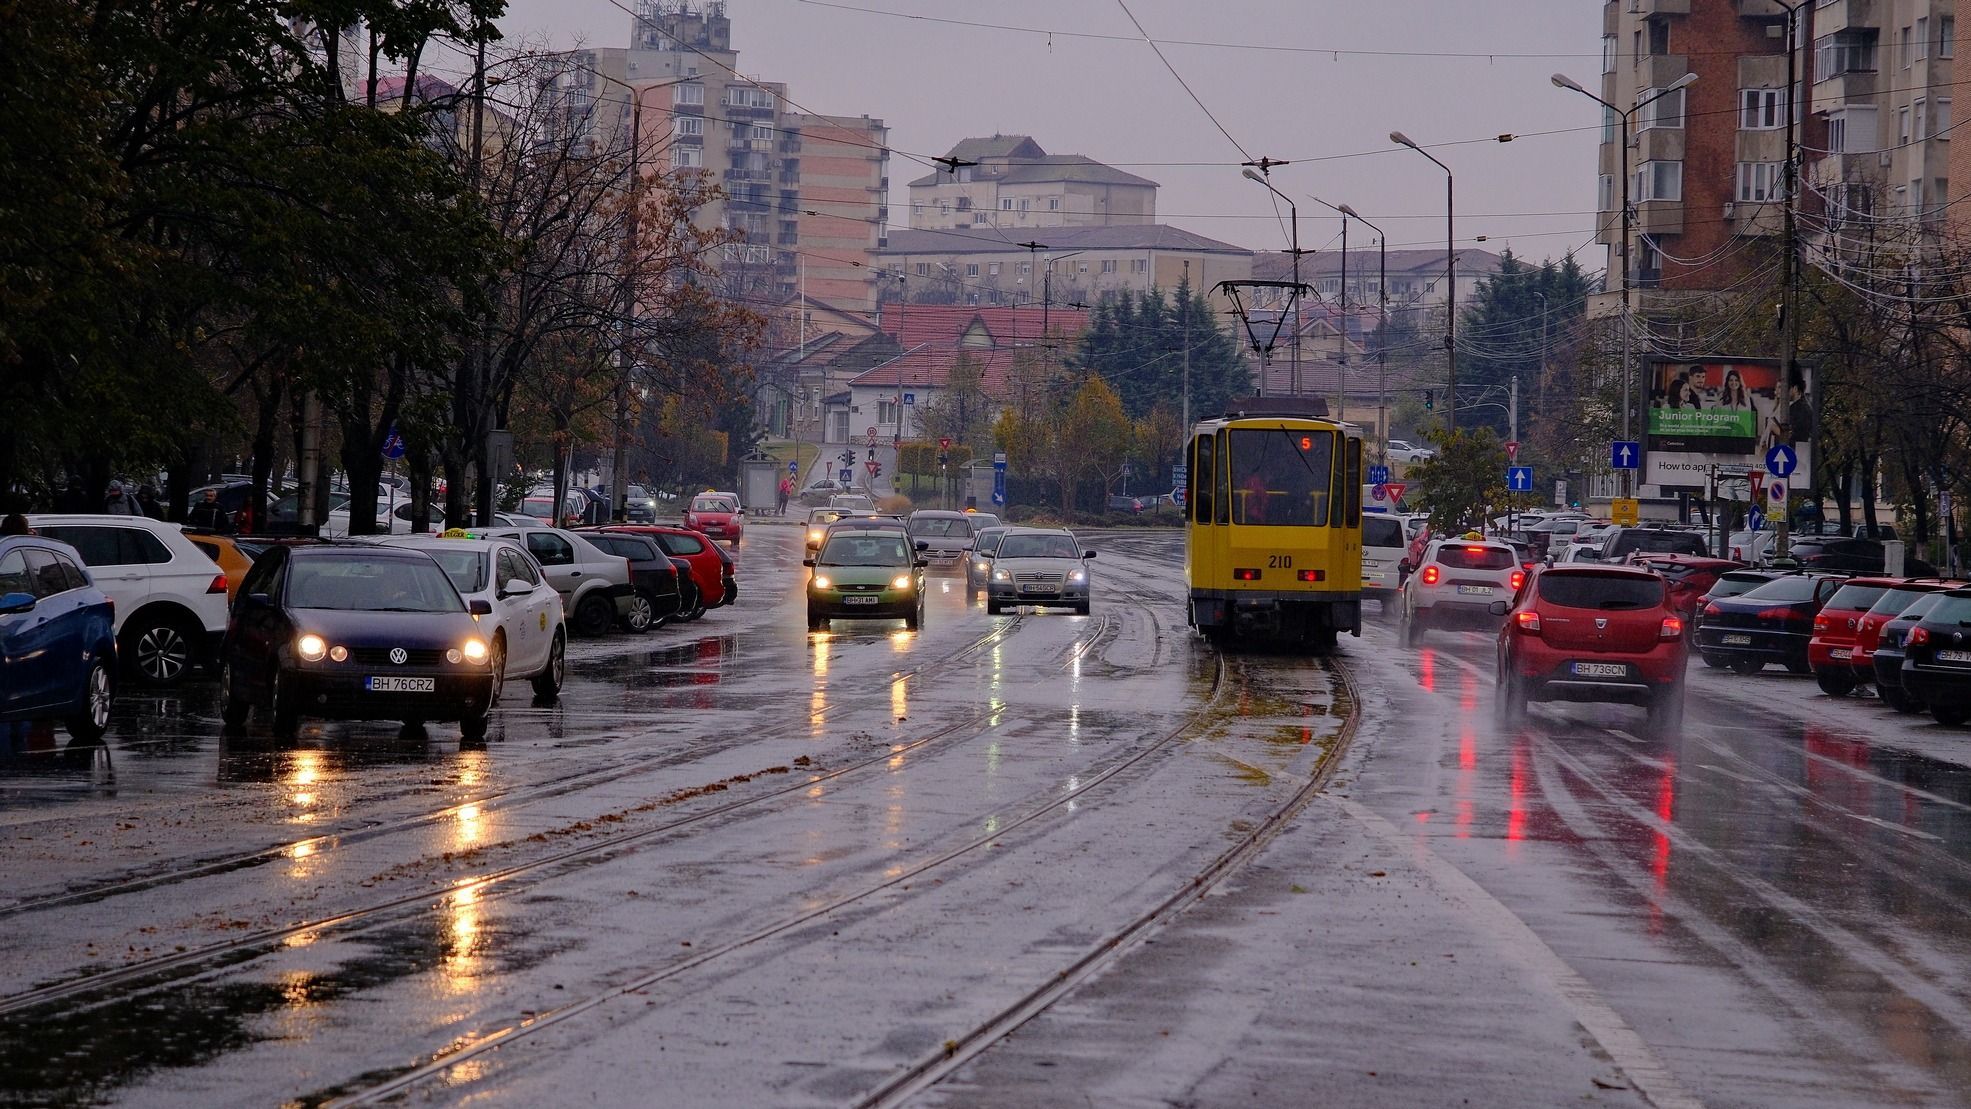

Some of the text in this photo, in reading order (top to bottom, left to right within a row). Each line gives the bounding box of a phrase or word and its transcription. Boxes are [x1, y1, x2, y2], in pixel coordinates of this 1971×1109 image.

[1658, 411, 1740, 423] Junior Program
[1301, 437, 1311, 450] 5
[1658, 461, 1680, 471] How
[1682, 462, 1691, 471] to
[1268, 555, 1292, 569] 210
[1576, 664, 1591, 673] BH
[372, 678, 433, 691] BH 76CRZ
